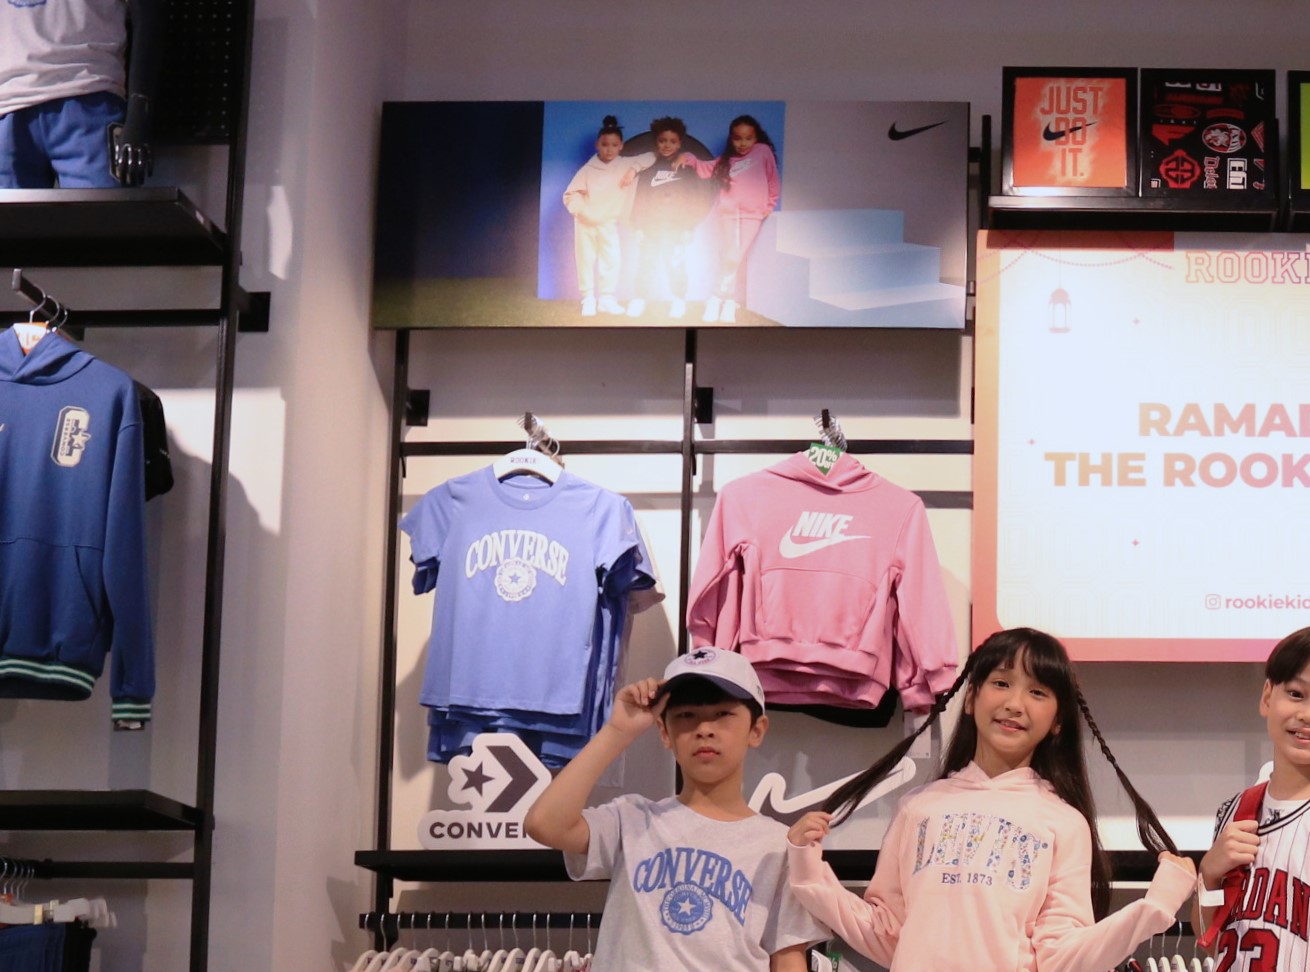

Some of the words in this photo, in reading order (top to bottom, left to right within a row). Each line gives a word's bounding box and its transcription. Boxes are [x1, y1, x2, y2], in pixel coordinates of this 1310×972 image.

[1040, 86, 1103, 115] JUST
[1055, 117, 1087, 146] DO
[1061, 148, 1085, 177] IT.
[809, 446, 838, 467] 20%
[1044, 451, 1147, 487] THE
[792, 511, 853, 538] NIKE
[465, 529, 570, 586] CONVERSE
[429, 821, 527, 840] CONVE
[633, 847, 752, 927] CONVERSE
[967, 873, 993, 886] 1873
